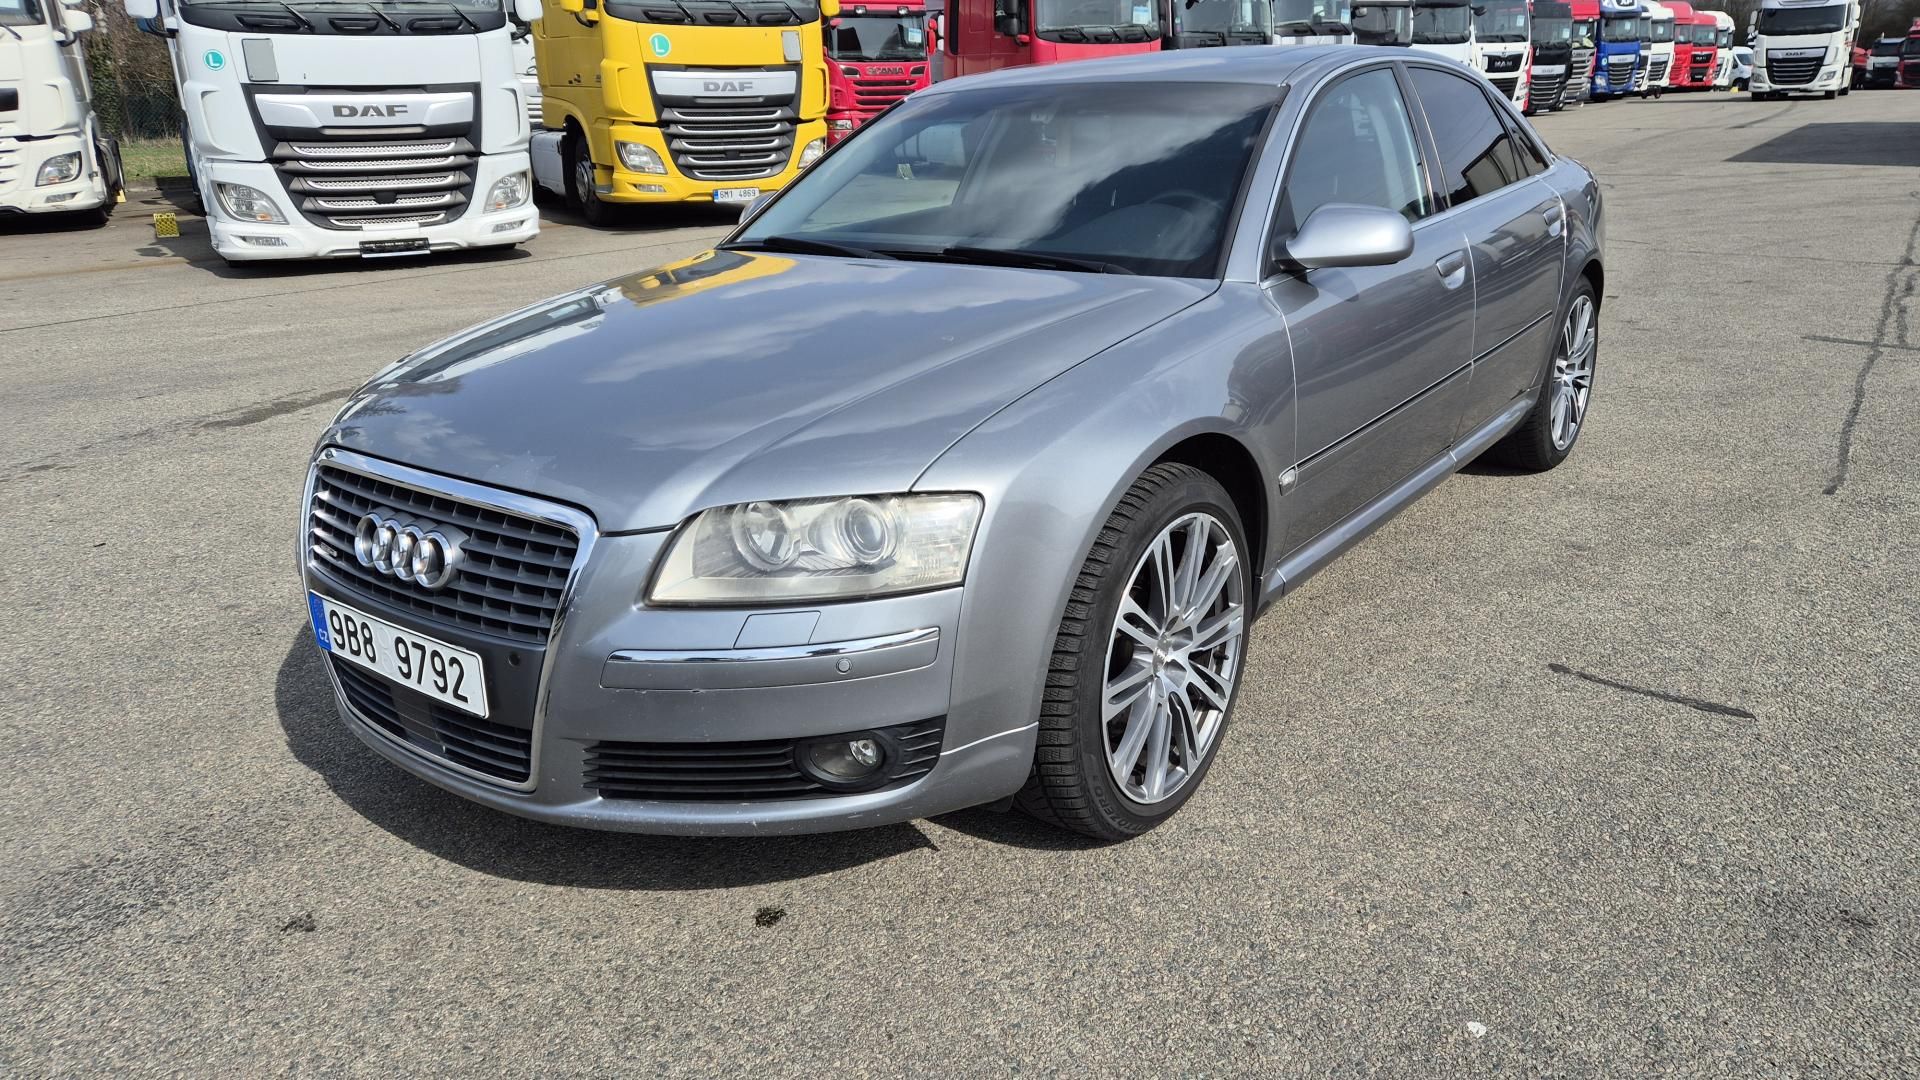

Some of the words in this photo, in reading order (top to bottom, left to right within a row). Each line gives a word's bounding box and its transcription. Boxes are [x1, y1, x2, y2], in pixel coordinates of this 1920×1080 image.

[654, 37, 665, 53] L
[208, 53, 220, 67] L
[867, 66, 904, 75] SCANIA
[703, 81, 753, 92] DAF
[332, 104, 408, 118] DAF
[720, 190, 733, 199] 6M1
[318, 628, 330, 643] CZ
[329, 609, 377, 664] 9B8
[394, 635, 469, 704] 9792
